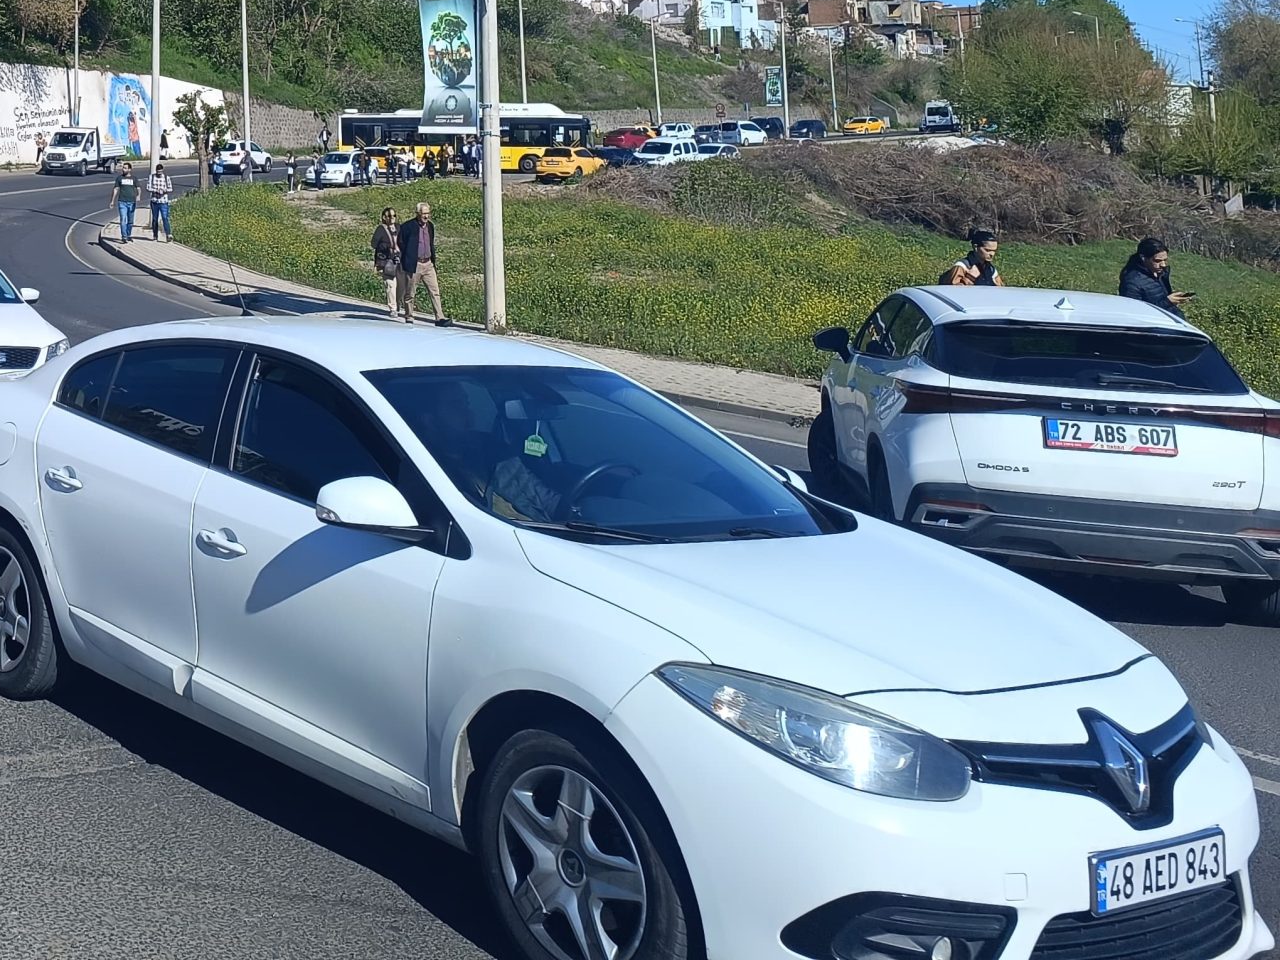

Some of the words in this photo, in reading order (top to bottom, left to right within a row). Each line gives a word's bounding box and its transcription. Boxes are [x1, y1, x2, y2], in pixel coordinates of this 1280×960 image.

[1061, 402, 1160, 416] CHERY
[1059, 422, 1082, 441] 72
[1094, 424, 1127, 444] ABS
[1138, 427, 1171, 447] 607
[1110, 862, 1135, 902] 48
[1143, 851, 1179, 895] AED
[1185, 842, 1220, 884] 843
